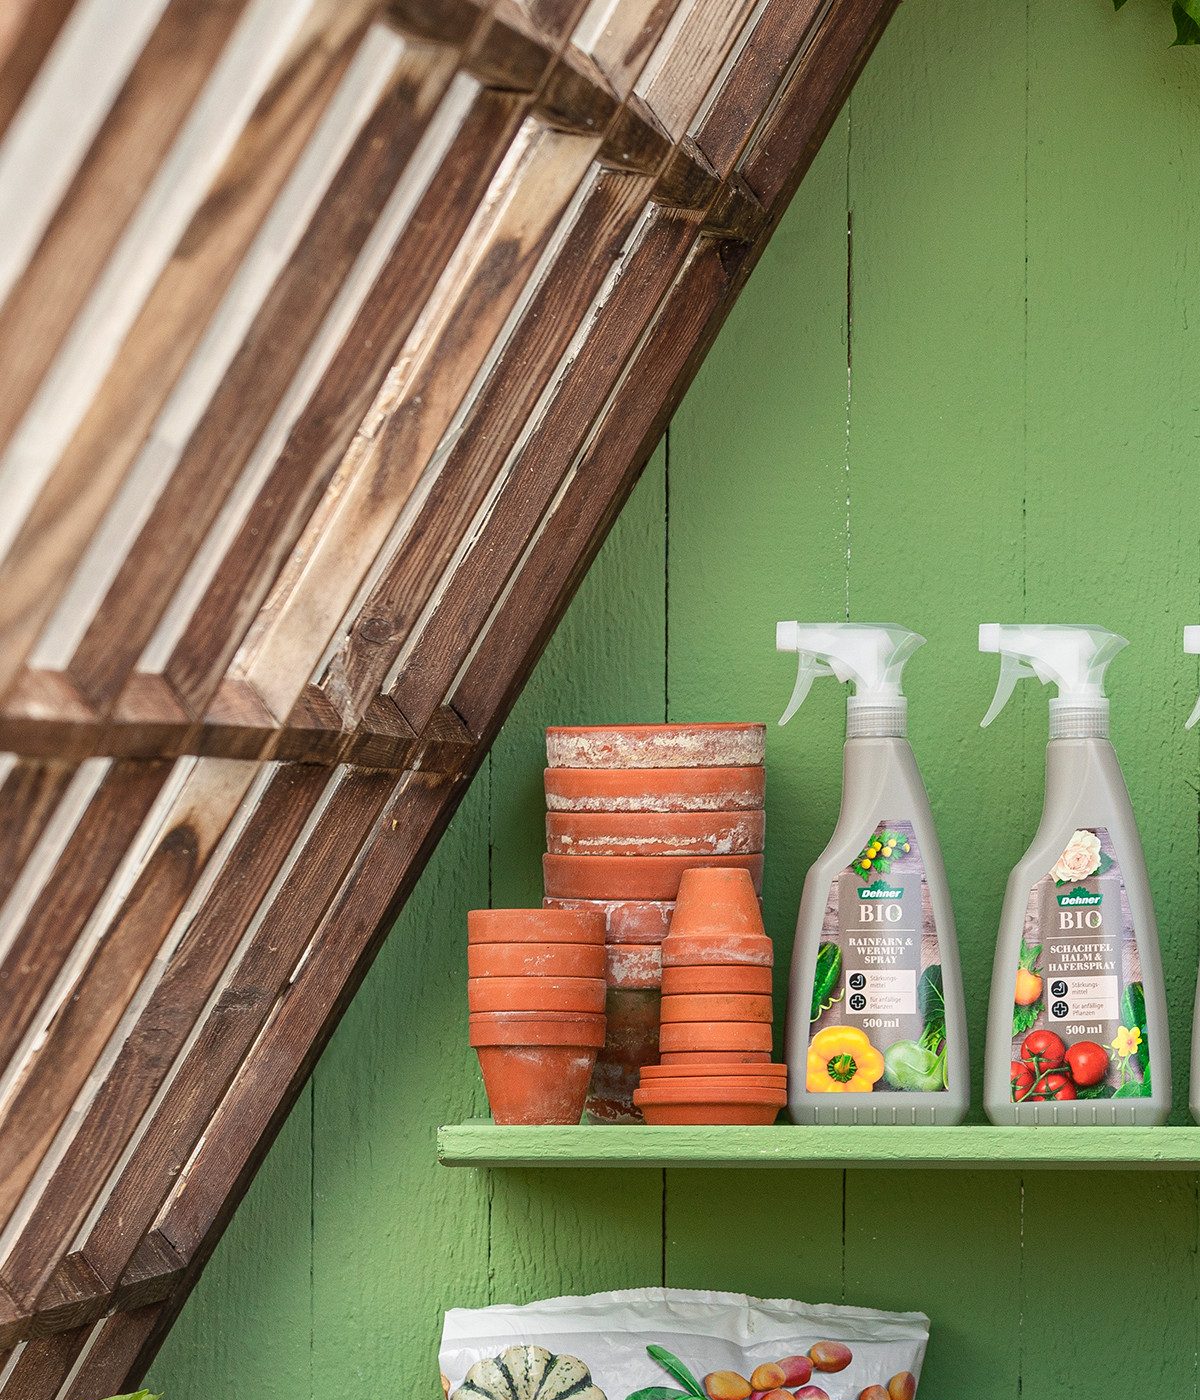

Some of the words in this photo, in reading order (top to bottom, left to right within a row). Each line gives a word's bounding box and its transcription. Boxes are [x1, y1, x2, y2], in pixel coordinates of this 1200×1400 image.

[862, 890, 901, 898] Dehner
[1061, 896, 1100, 905] Dehner
[859, 904, 902, 922] BIO
[1059, 911, 1102, 930] BIO
[849, 938, 902, 946] RAINFARN
[905, 938, 913, 946] &
[857, 947, 905, 955] WERMUT
[1050, 944, 1113, 953] SCHACHTEL
[1062, 953, 1092, 962] HALM
[1049, 961, 1116, 971] HAFERSPRAY
[863, 1019, 882, 1028] 500
[884, 1019, 899, 1028] ml
[1066, 1025, 1085, 1035] 500
[1087, 1024, 1102, 1034] ml
